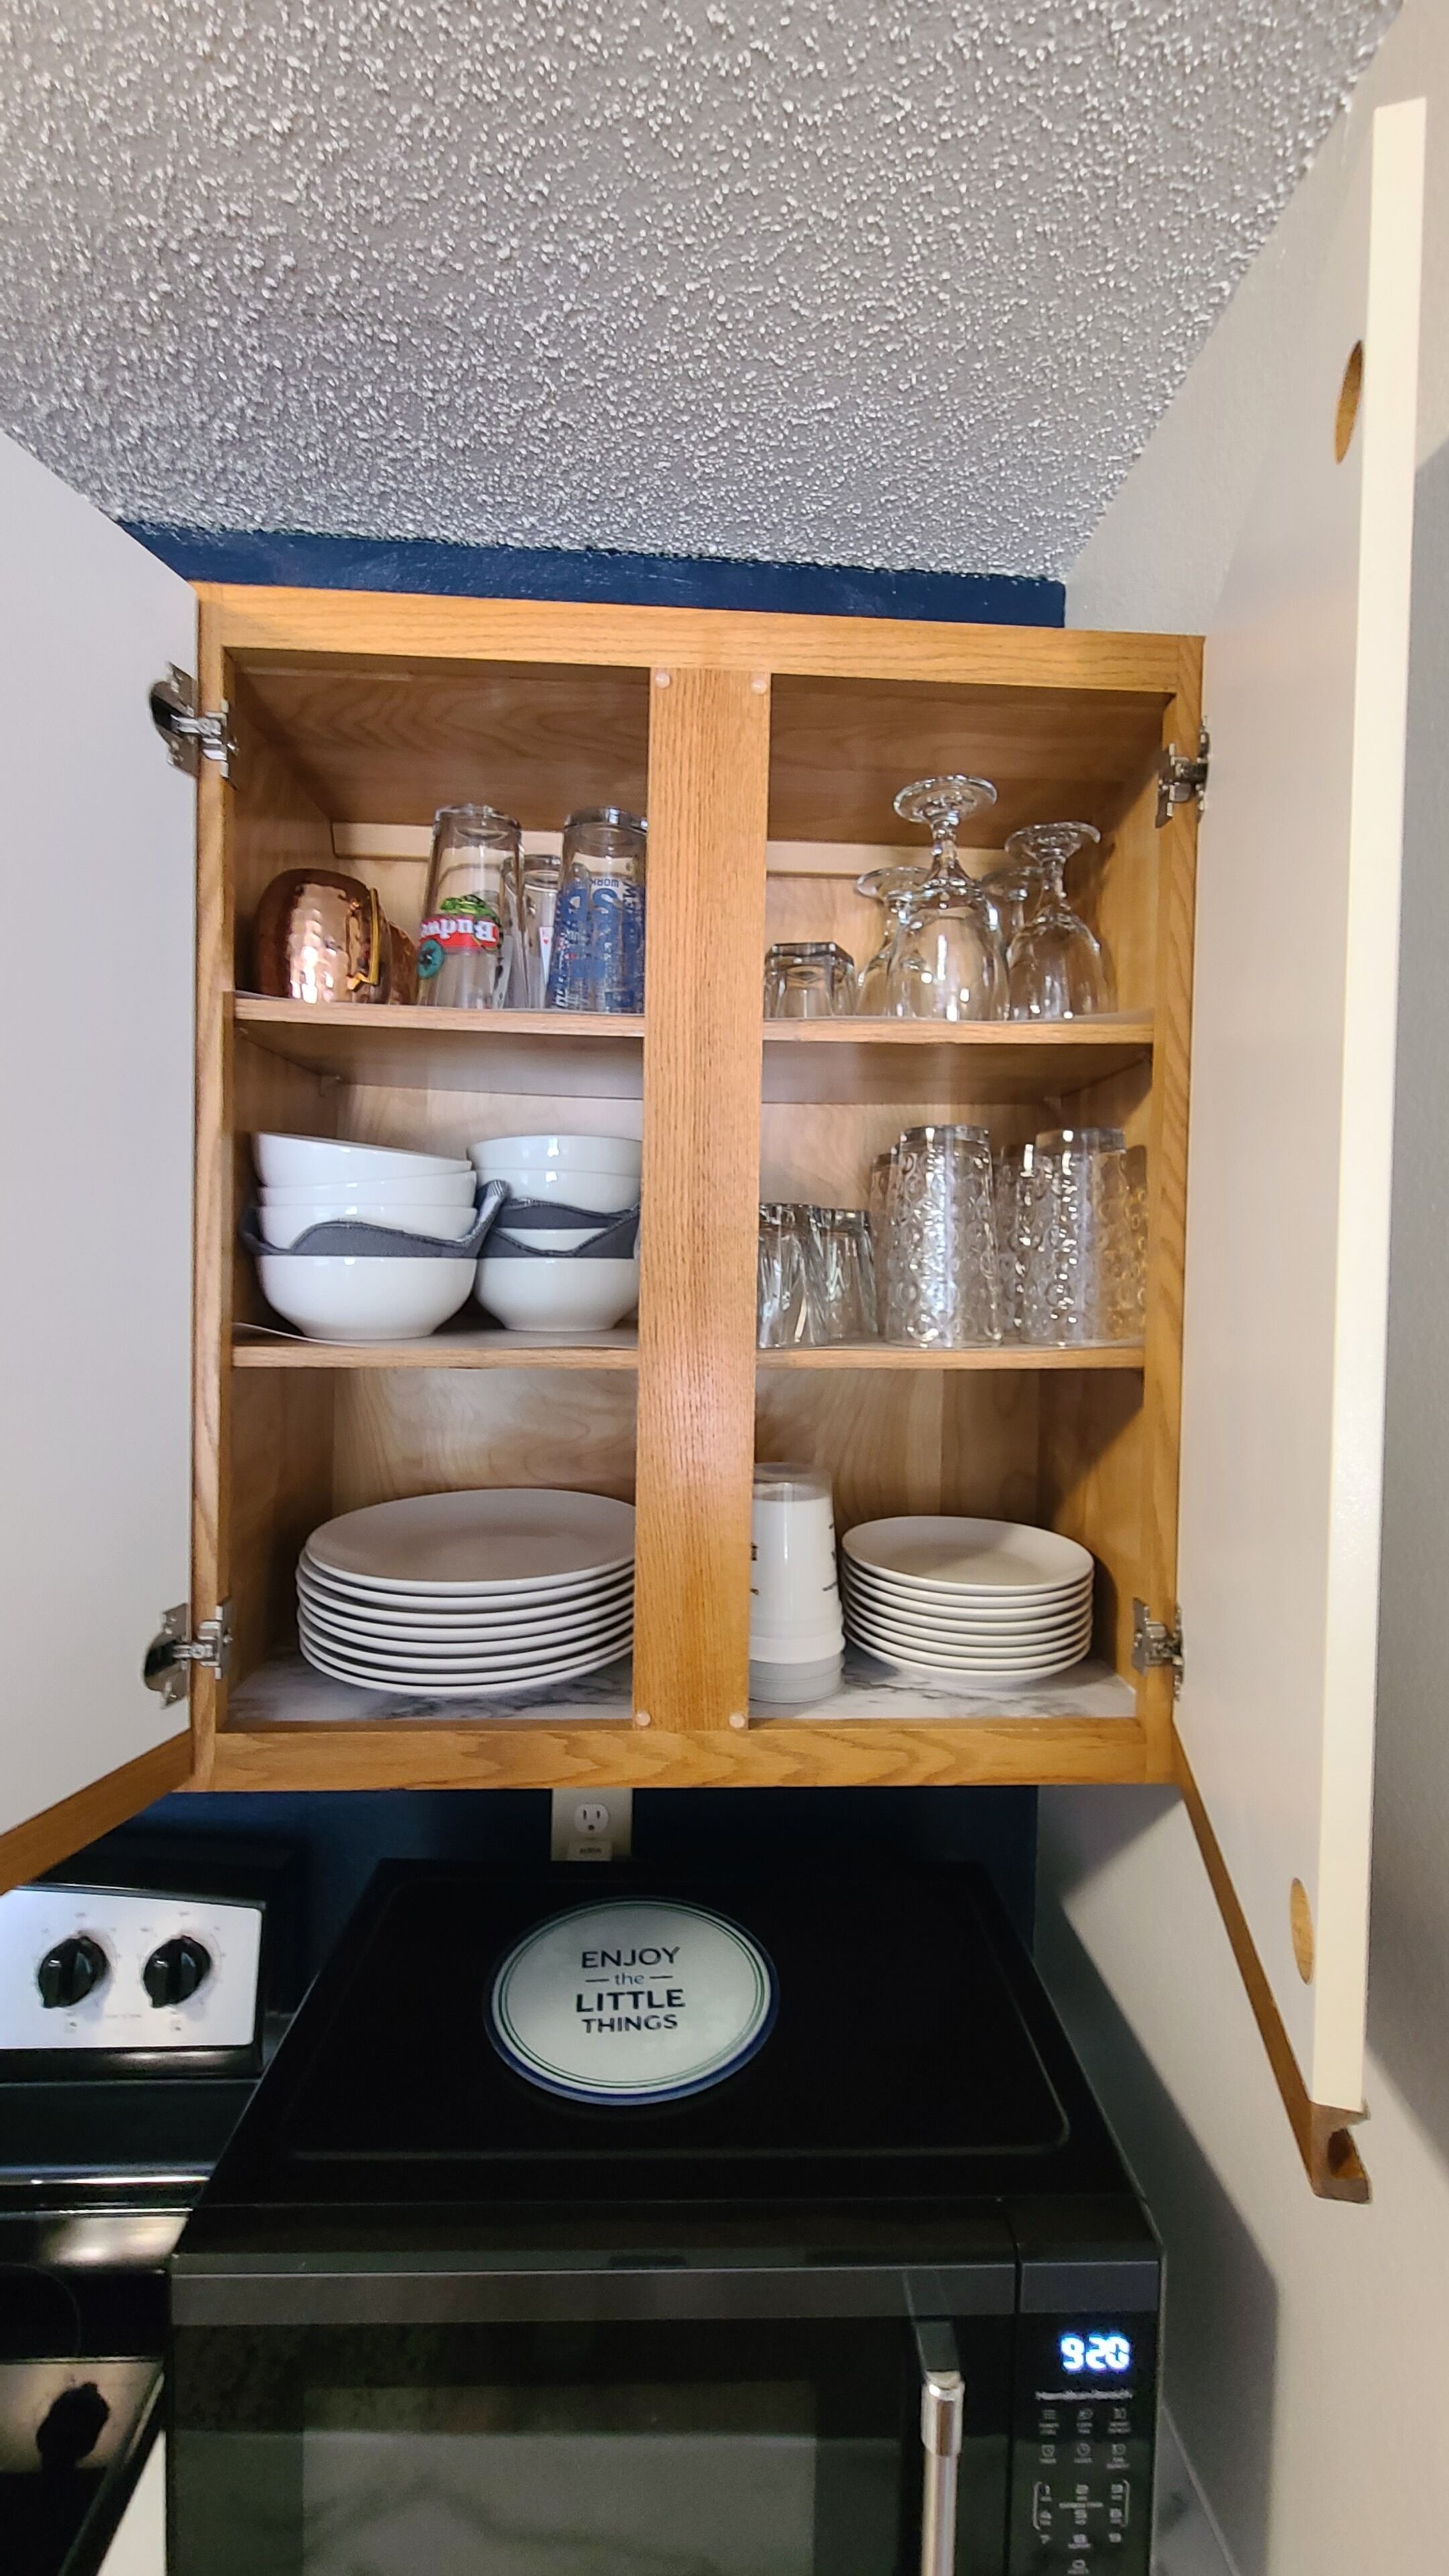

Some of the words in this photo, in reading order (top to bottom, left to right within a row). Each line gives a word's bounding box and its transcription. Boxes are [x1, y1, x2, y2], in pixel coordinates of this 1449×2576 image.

[582, 1946, 680, 1968] ENJOY
[614, 1972, 645, 1986] the
[576, 1989, 686, 2012] LITTLE
[582, 2014, 678, 2033] THINGS
